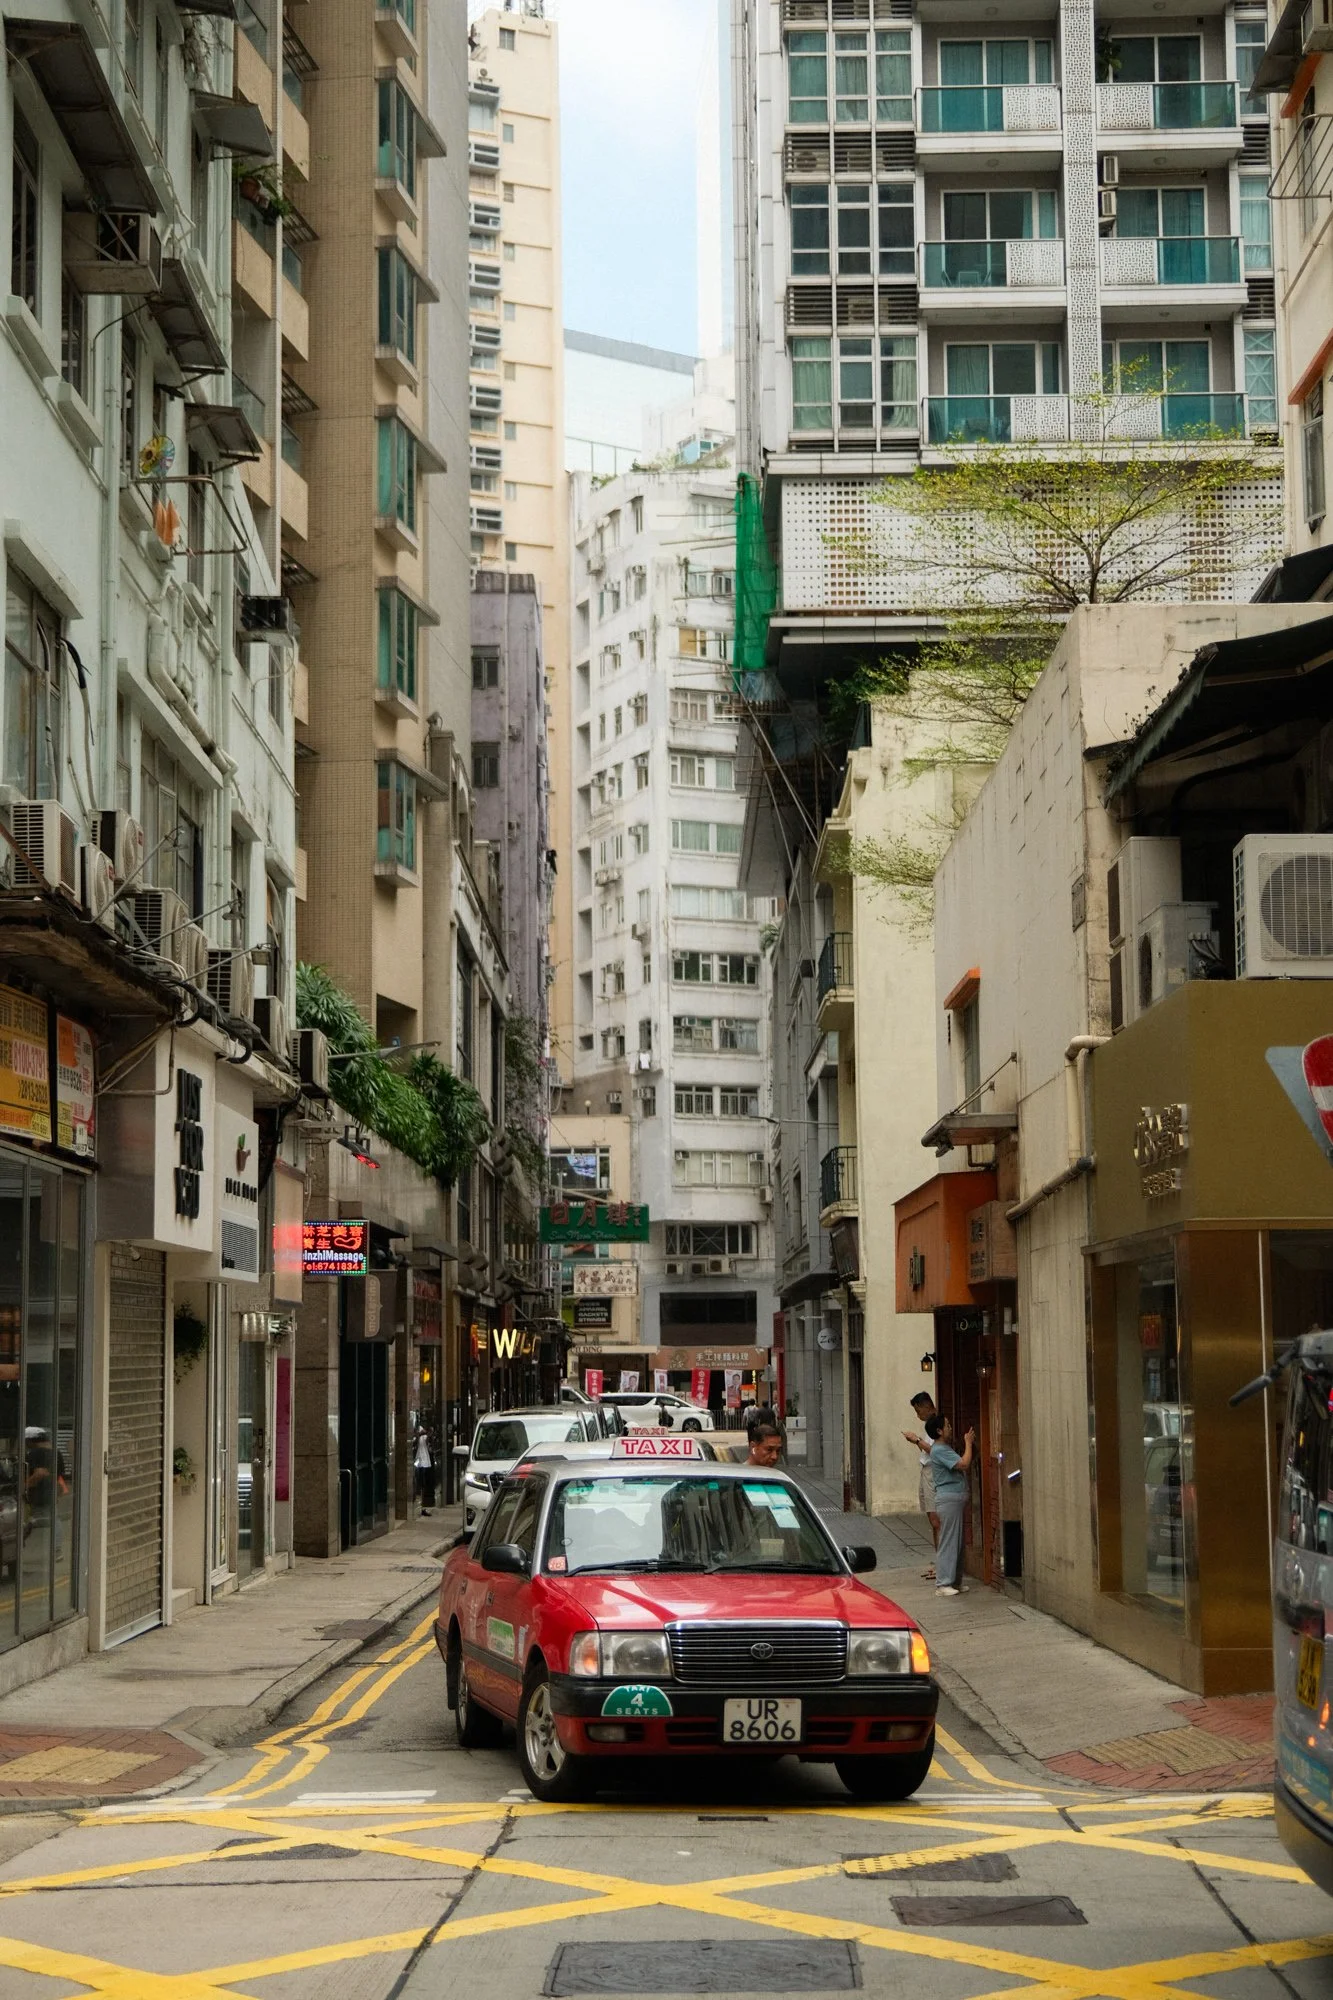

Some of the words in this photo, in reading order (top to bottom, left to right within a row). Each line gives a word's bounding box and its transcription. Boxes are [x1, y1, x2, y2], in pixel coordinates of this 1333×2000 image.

[571, 1346, 603, 1354] UILDING
[632, 1427, 666, 1435] TAXI
[621, 1439, 693, 1455] TAXI
[623, 1685, 652, 1693] TAXI
[630, 1692, 645, 1707] 4
[616, 1707, 659, 1715] SEATS
[747, 1699, 779, 1720] UR
[729, 1720, 796, 1740] 8606
